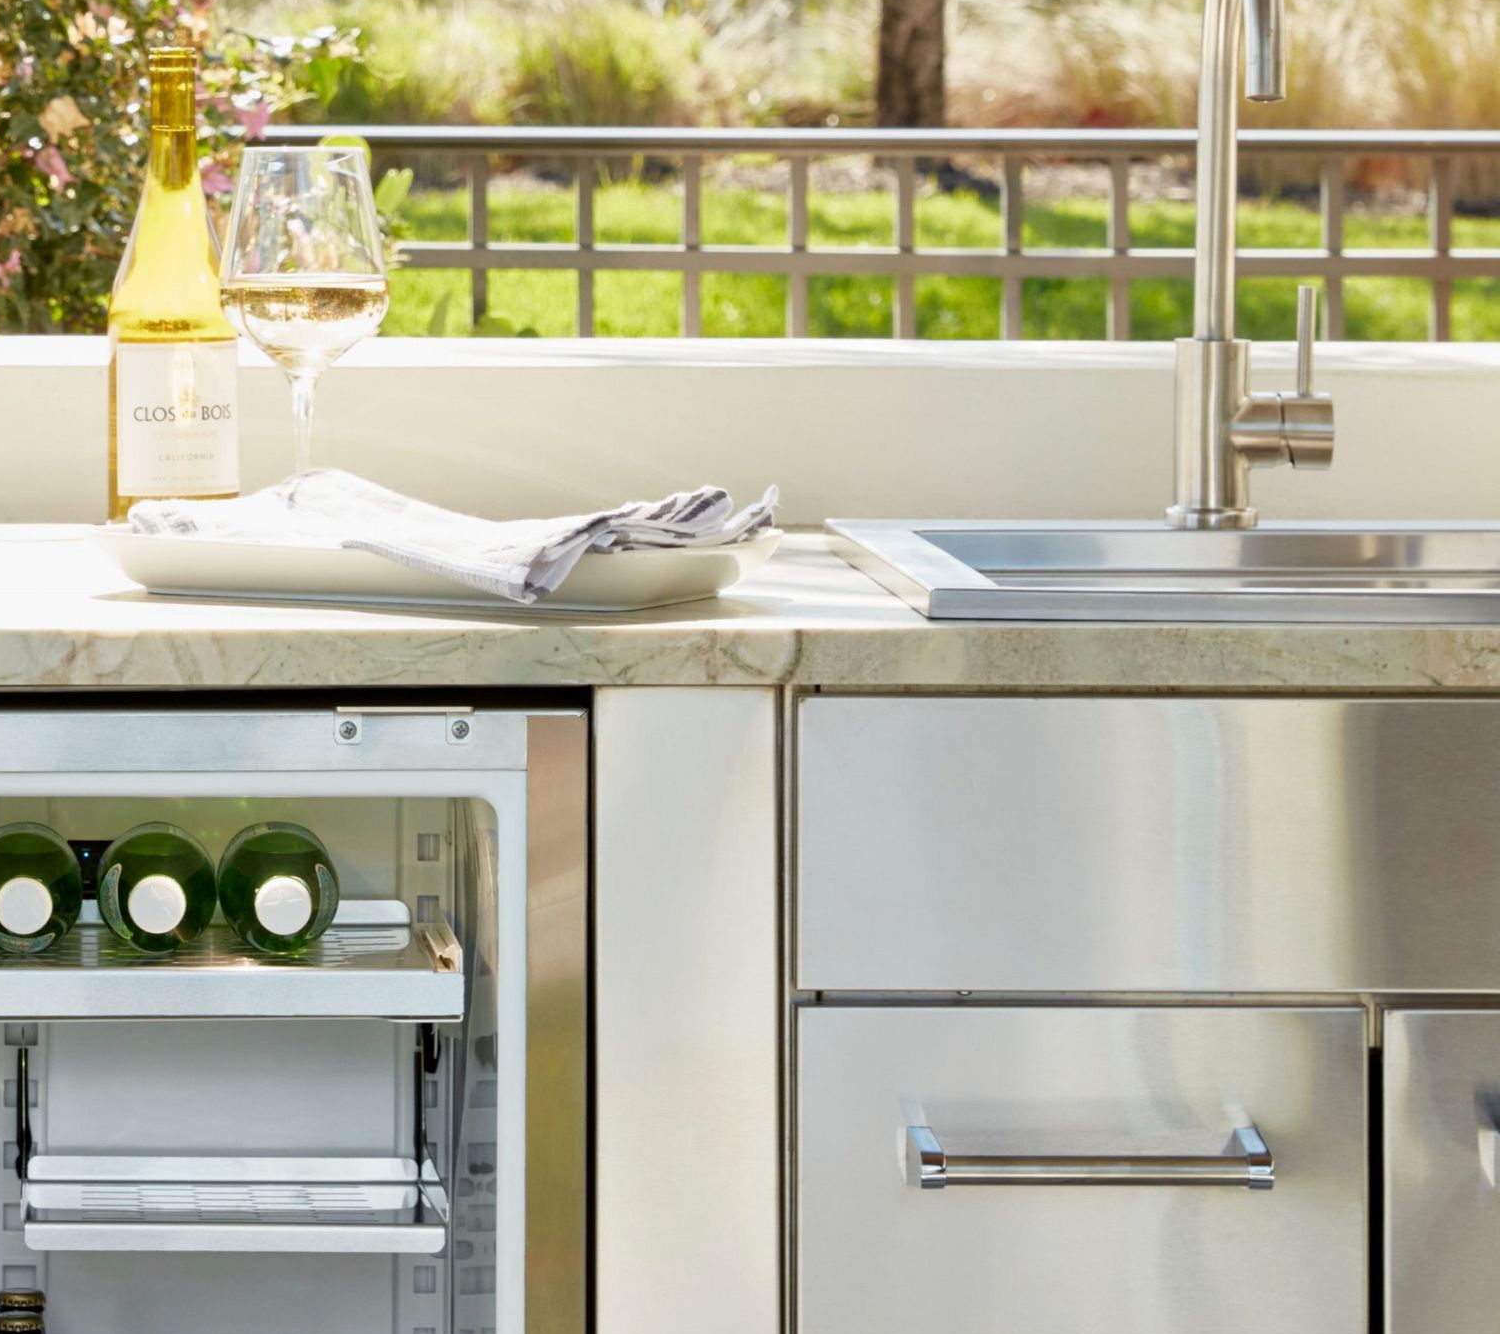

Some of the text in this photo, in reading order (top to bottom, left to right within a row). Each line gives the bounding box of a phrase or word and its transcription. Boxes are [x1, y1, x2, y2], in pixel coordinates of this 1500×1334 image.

[133, 406, 176, 422] CLOS
[201, 404, 231, 421] BOIS
[158, 453, 215, 462] CALIFORNIA
